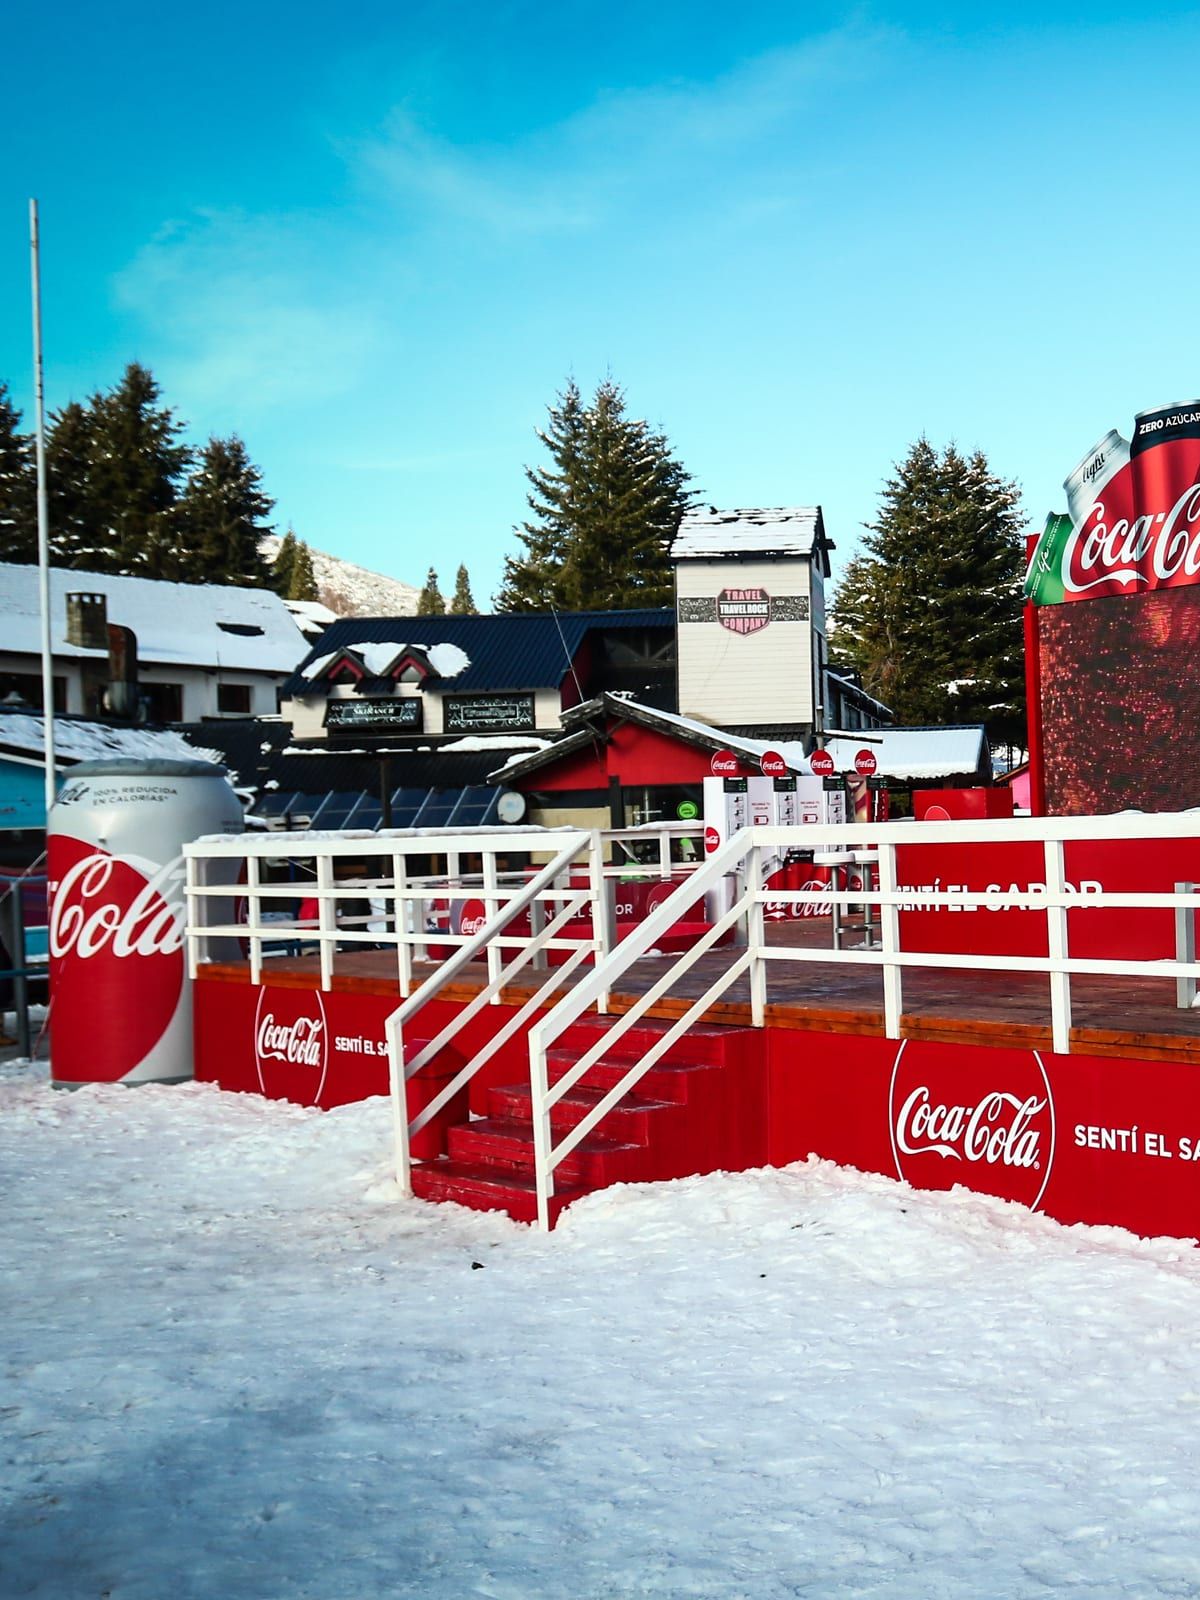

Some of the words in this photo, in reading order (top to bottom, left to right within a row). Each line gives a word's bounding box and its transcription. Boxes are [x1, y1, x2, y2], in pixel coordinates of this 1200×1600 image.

[1138, 419, 1164, 435] ZERO
[1082, 452, 1106, 483] light
[724, 590, 762, 600] TRAVEL
[723, 617, 767, 633] COMPANY
[121, 786, 179, 796] REDUCIDA
[257, 1013, 324, 1067] Coca-Cola
[335, 1035, 363, 1053] SENTÍ
[363, 1040, 376, 1055] EL
[896, 1086, 1048, 1170] Coca-Cola
[1073, 1123, 1138, 1154] SENTÍ
[1144, 1132, 1173, 1159] EL
